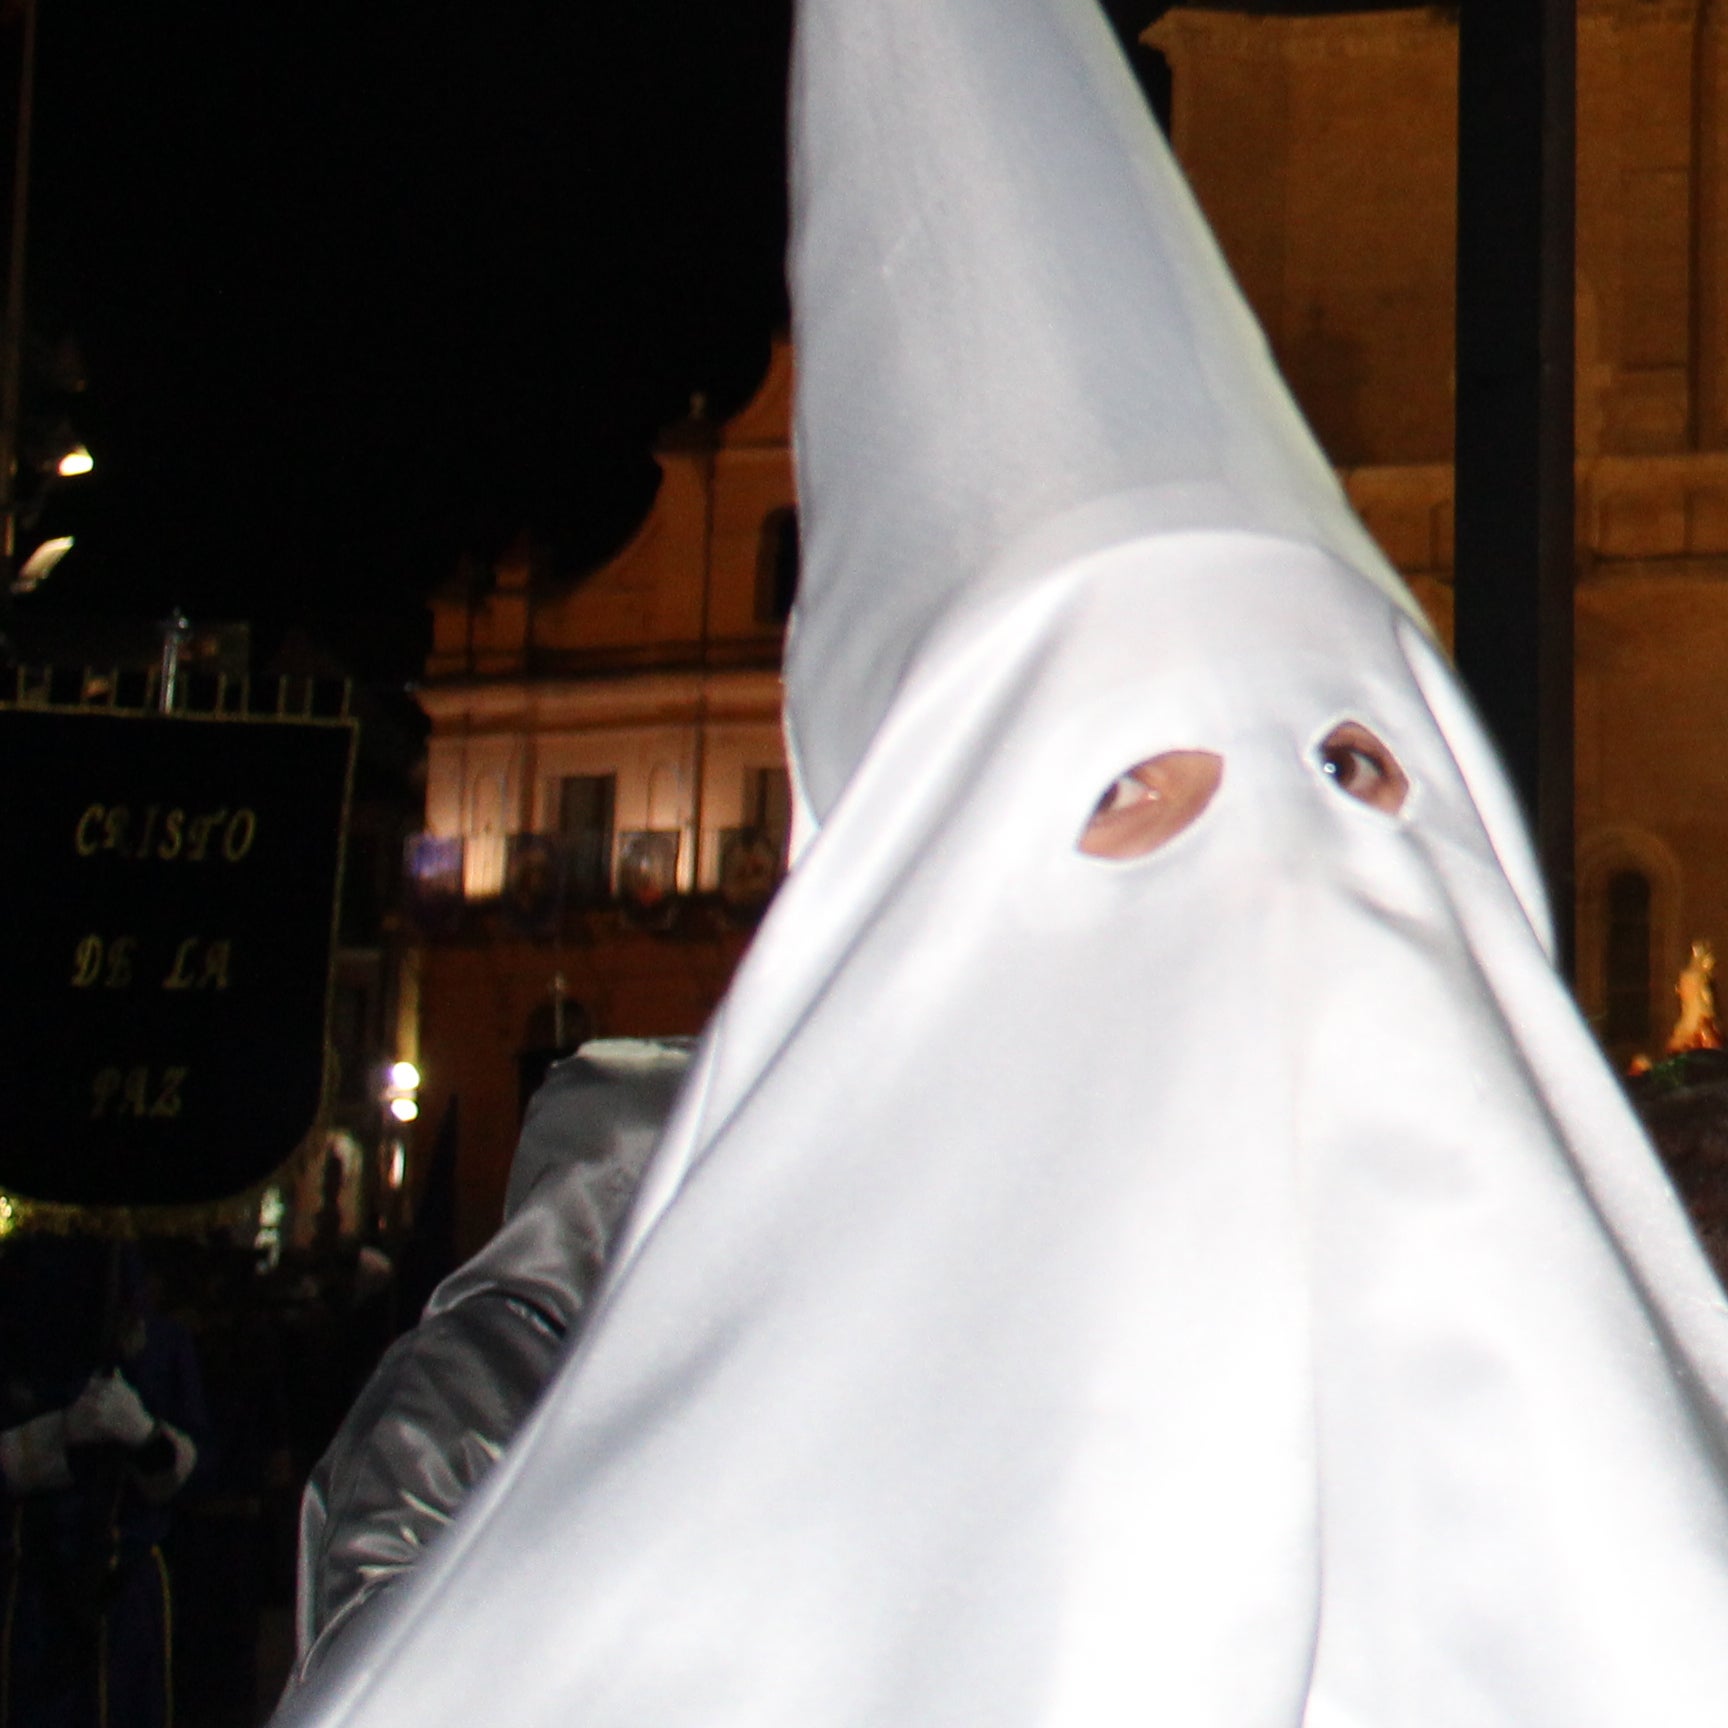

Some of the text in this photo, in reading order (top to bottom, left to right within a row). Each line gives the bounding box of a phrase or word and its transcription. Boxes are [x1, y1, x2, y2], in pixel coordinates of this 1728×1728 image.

[74, 801, 257, 863] CRISTO
[68, 932, 232, 990] DE LA
[88, 1064, 191, 1120] PAZ
